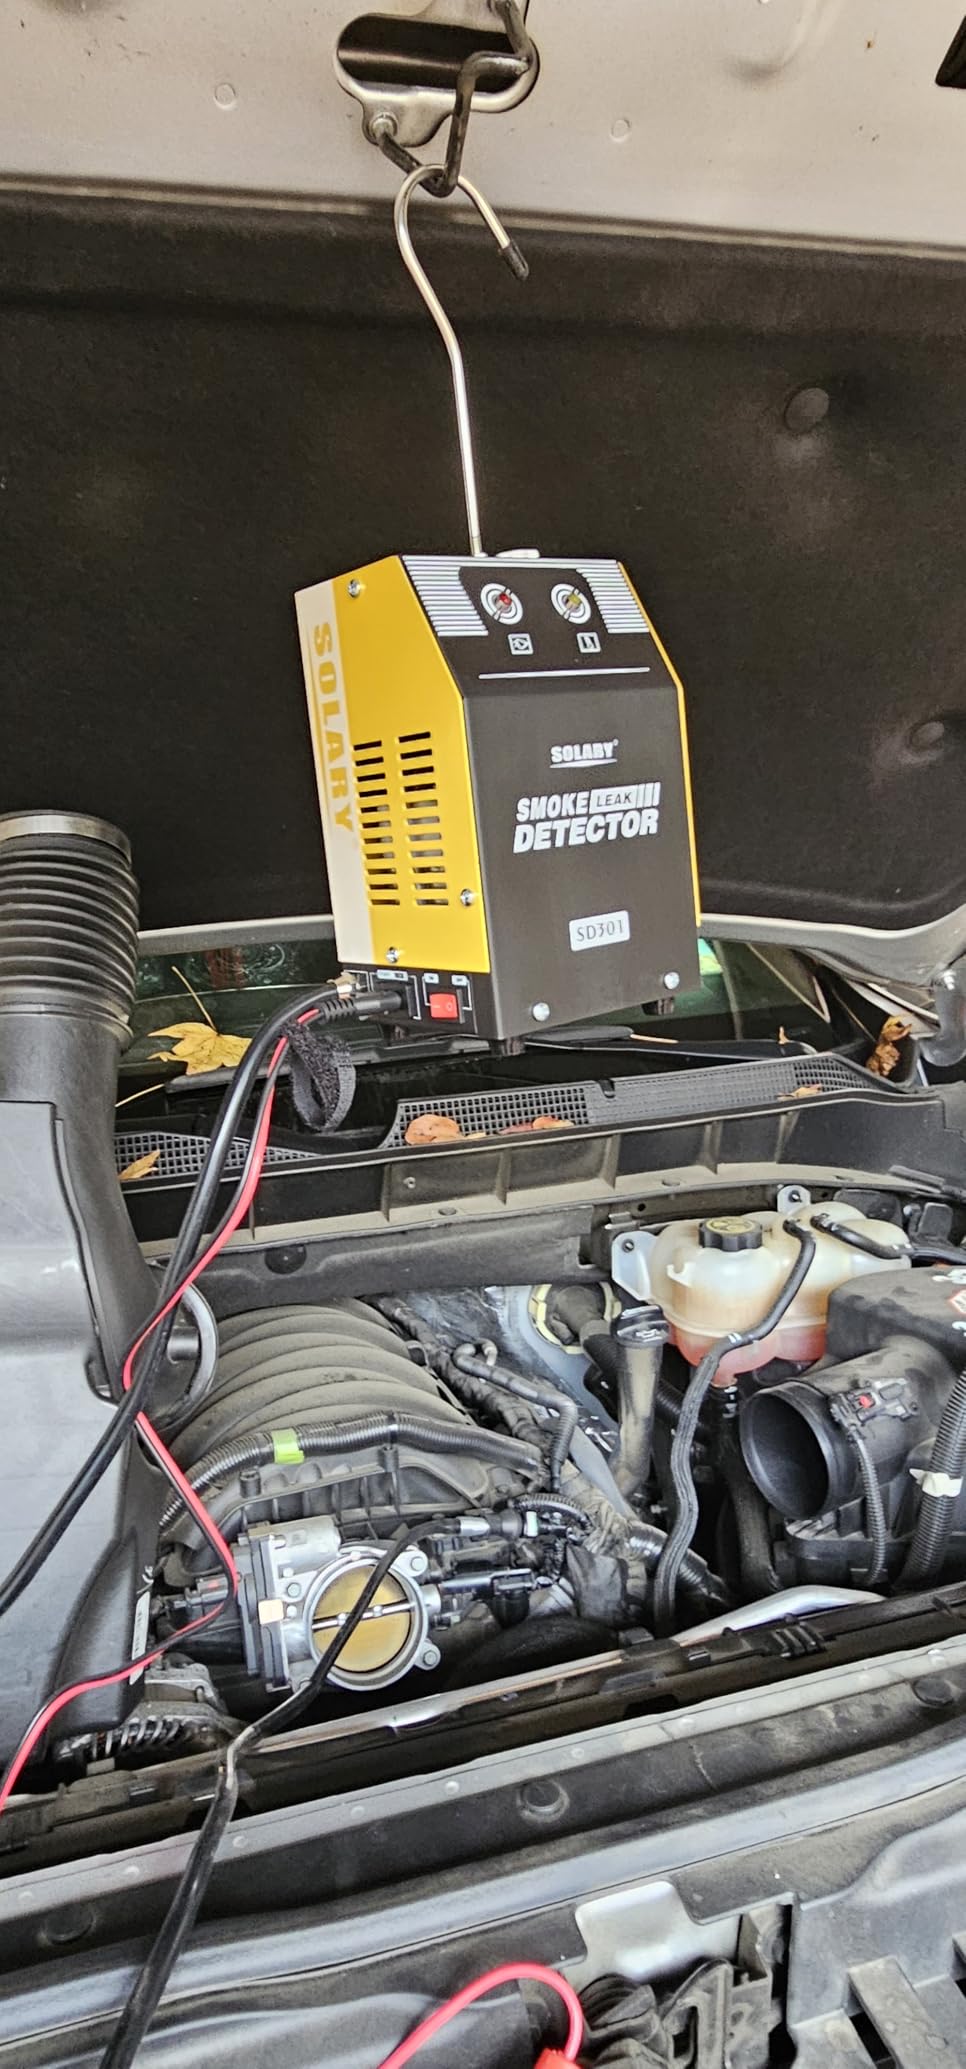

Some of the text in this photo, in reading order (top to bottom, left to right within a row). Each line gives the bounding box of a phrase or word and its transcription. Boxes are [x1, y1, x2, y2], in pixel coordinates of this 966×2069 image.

[314, 622, 354, 832] SOLARY
[516, 791, 633, 822] SMOKE LEAK
[513, 808, 660, 854] DETECTOR
[576, 919, 623, 942] SD301
